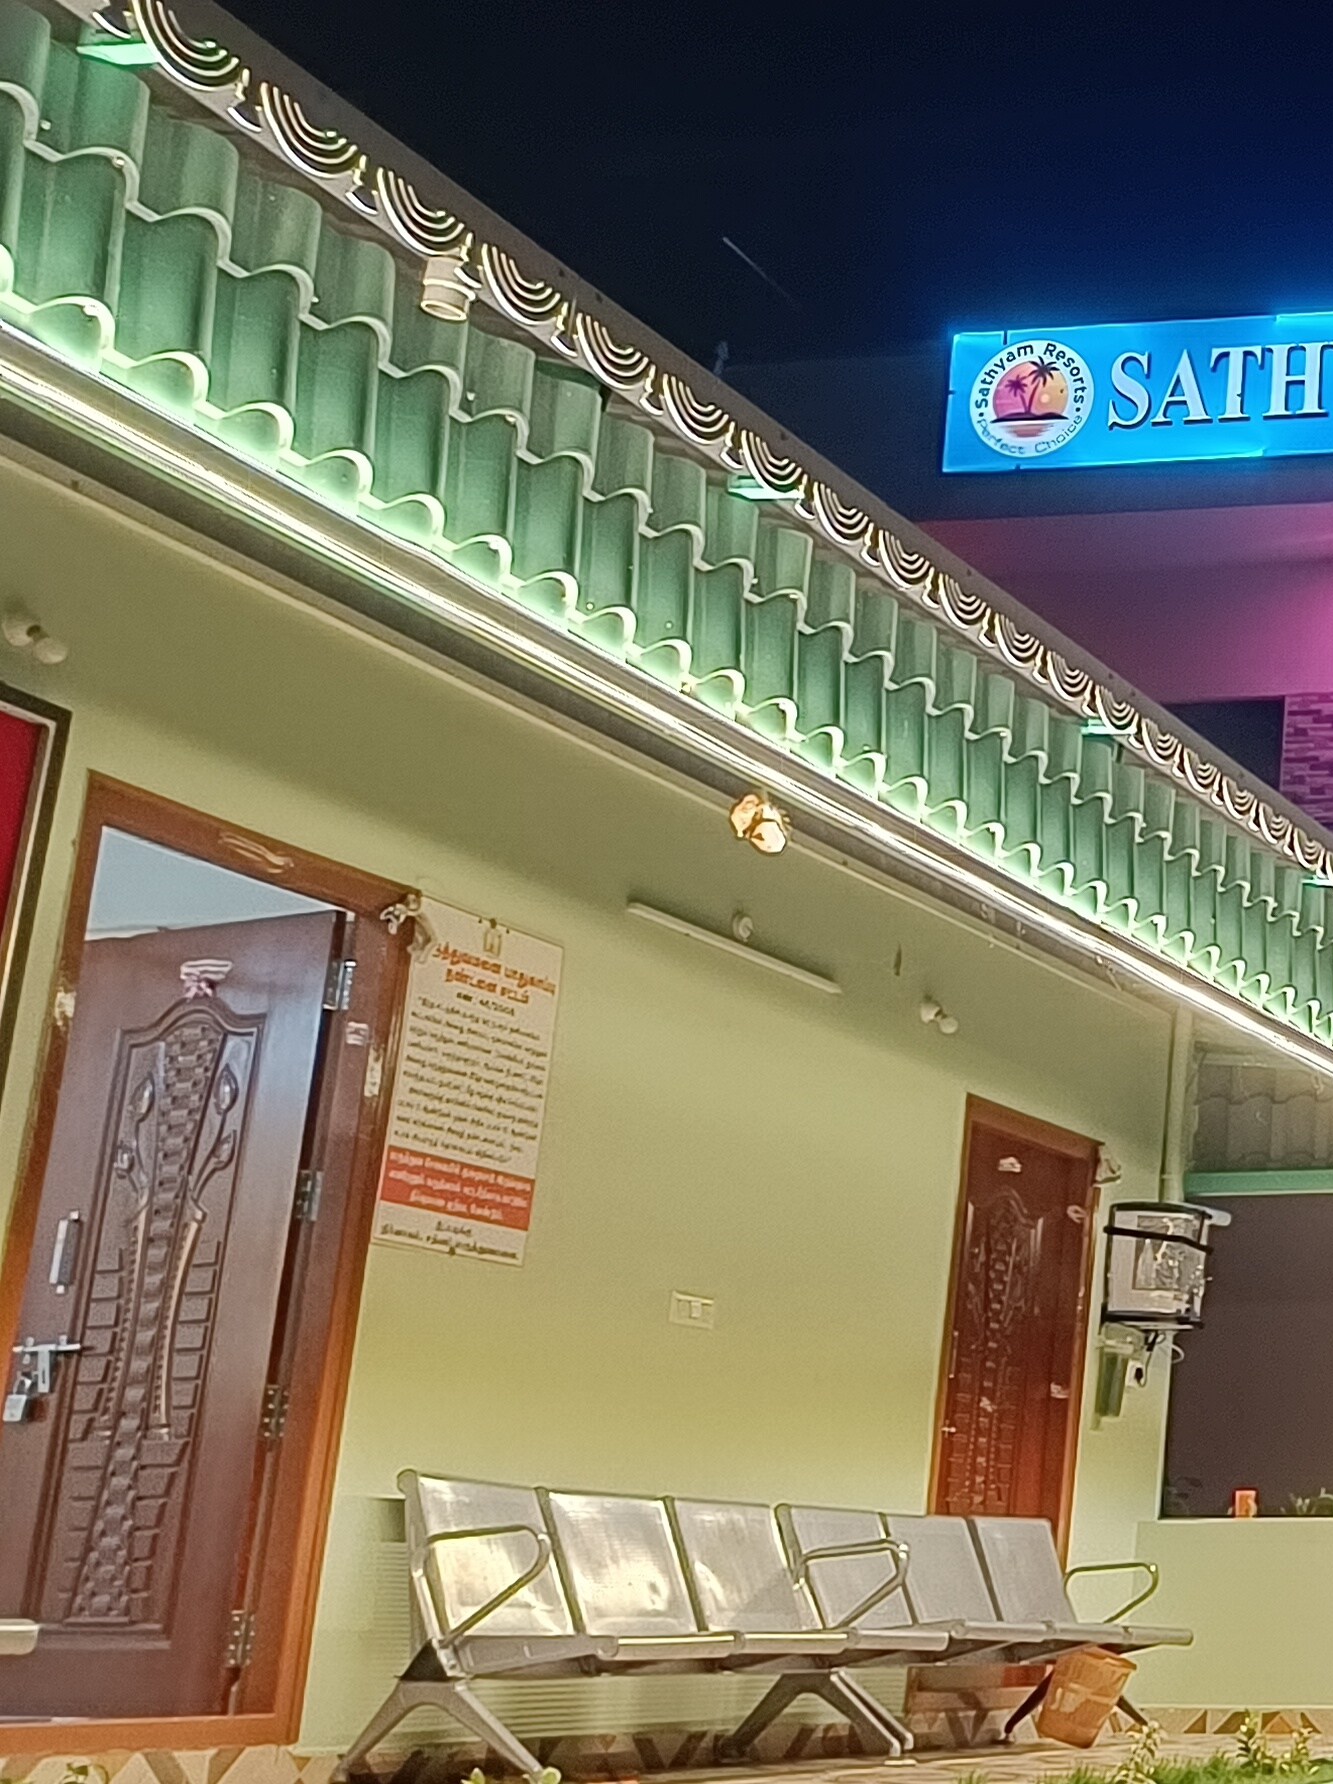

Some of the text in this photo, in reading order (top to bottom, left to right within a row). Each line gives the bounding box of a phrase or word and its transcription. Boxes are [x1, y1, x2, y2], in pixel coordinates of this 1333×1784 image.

[975, 343, 1087, 408] Sathyam Resorts
[977, 415, 1083, 455] Perfect Choice
